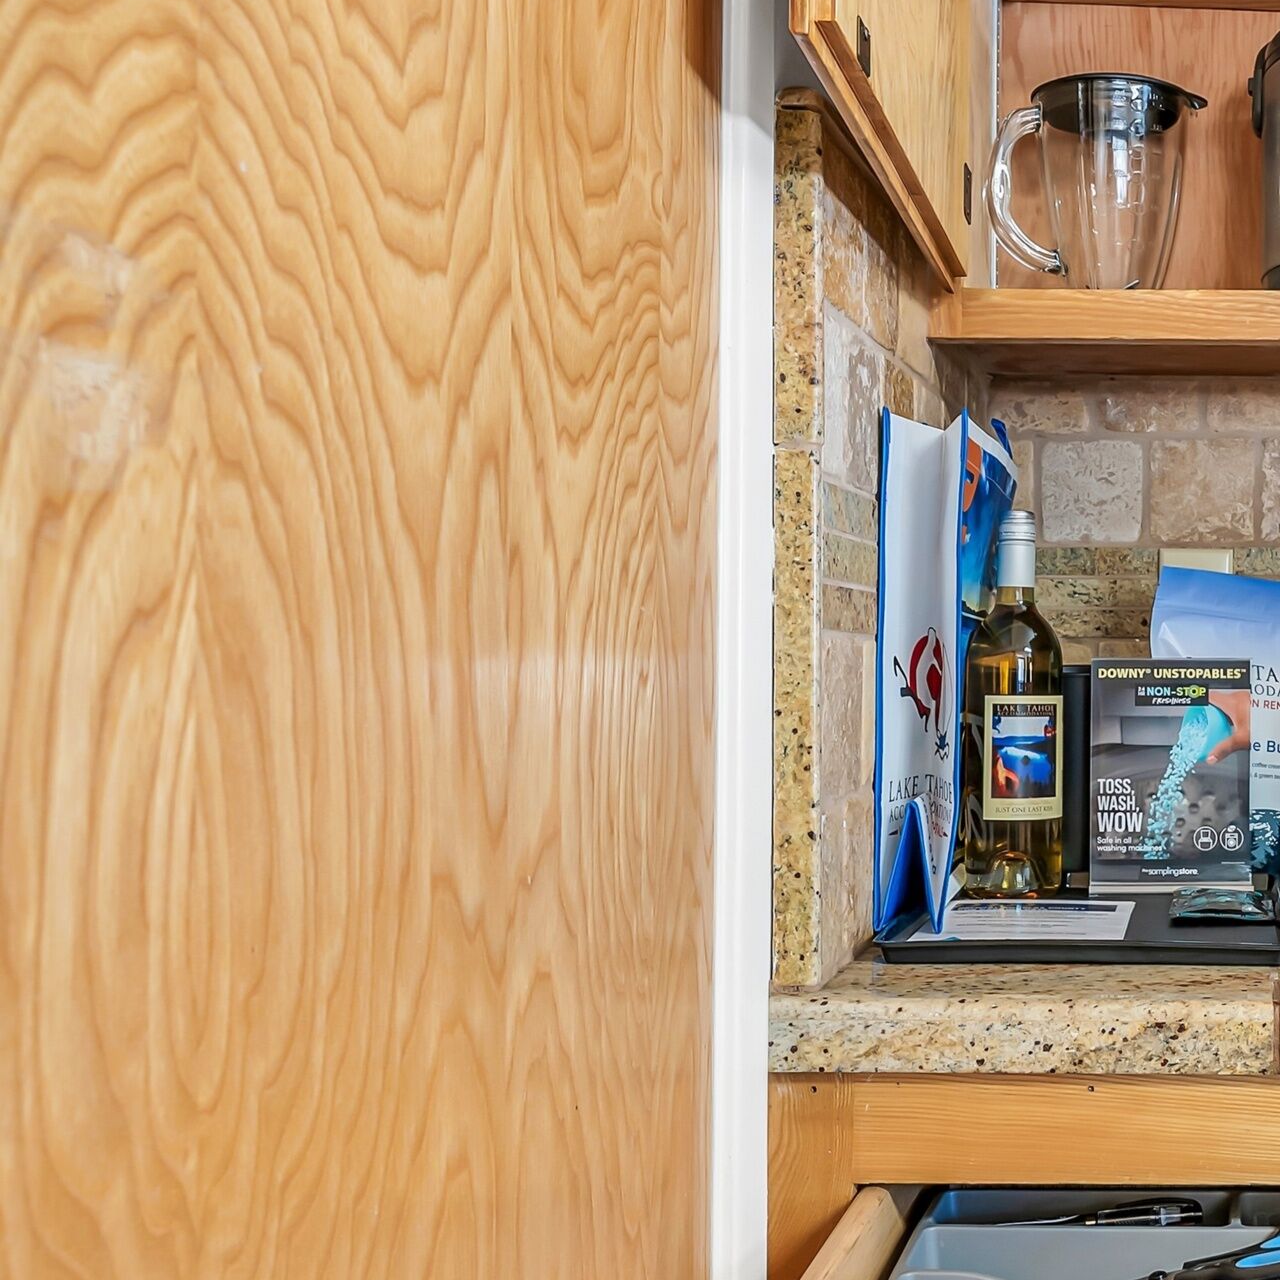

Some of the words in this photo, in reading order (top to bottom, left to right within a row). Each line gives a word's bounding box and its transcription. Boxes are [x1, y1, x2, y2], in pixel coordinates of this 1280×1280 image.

[1146, 686, 1206, 697] NON-STOP
[997, 704, 1021, 712] LAKE
[889, 775, 919, 803] LAKE
[925, 774, 953, 804] TAHOE
[1097, 778, 1135, 795] TOSS,
[1097, 795, 1140, 813] WASH,
[1097, 812, 1143, 833] WOW
[1097, 836, 1113, 845] Safe
[1114, 836, 1122, 844] in
[1123, 836, 1132, 844] all
[1097, 844, 1127, 853] washing
[1128, 844, 1163, 852] machines
